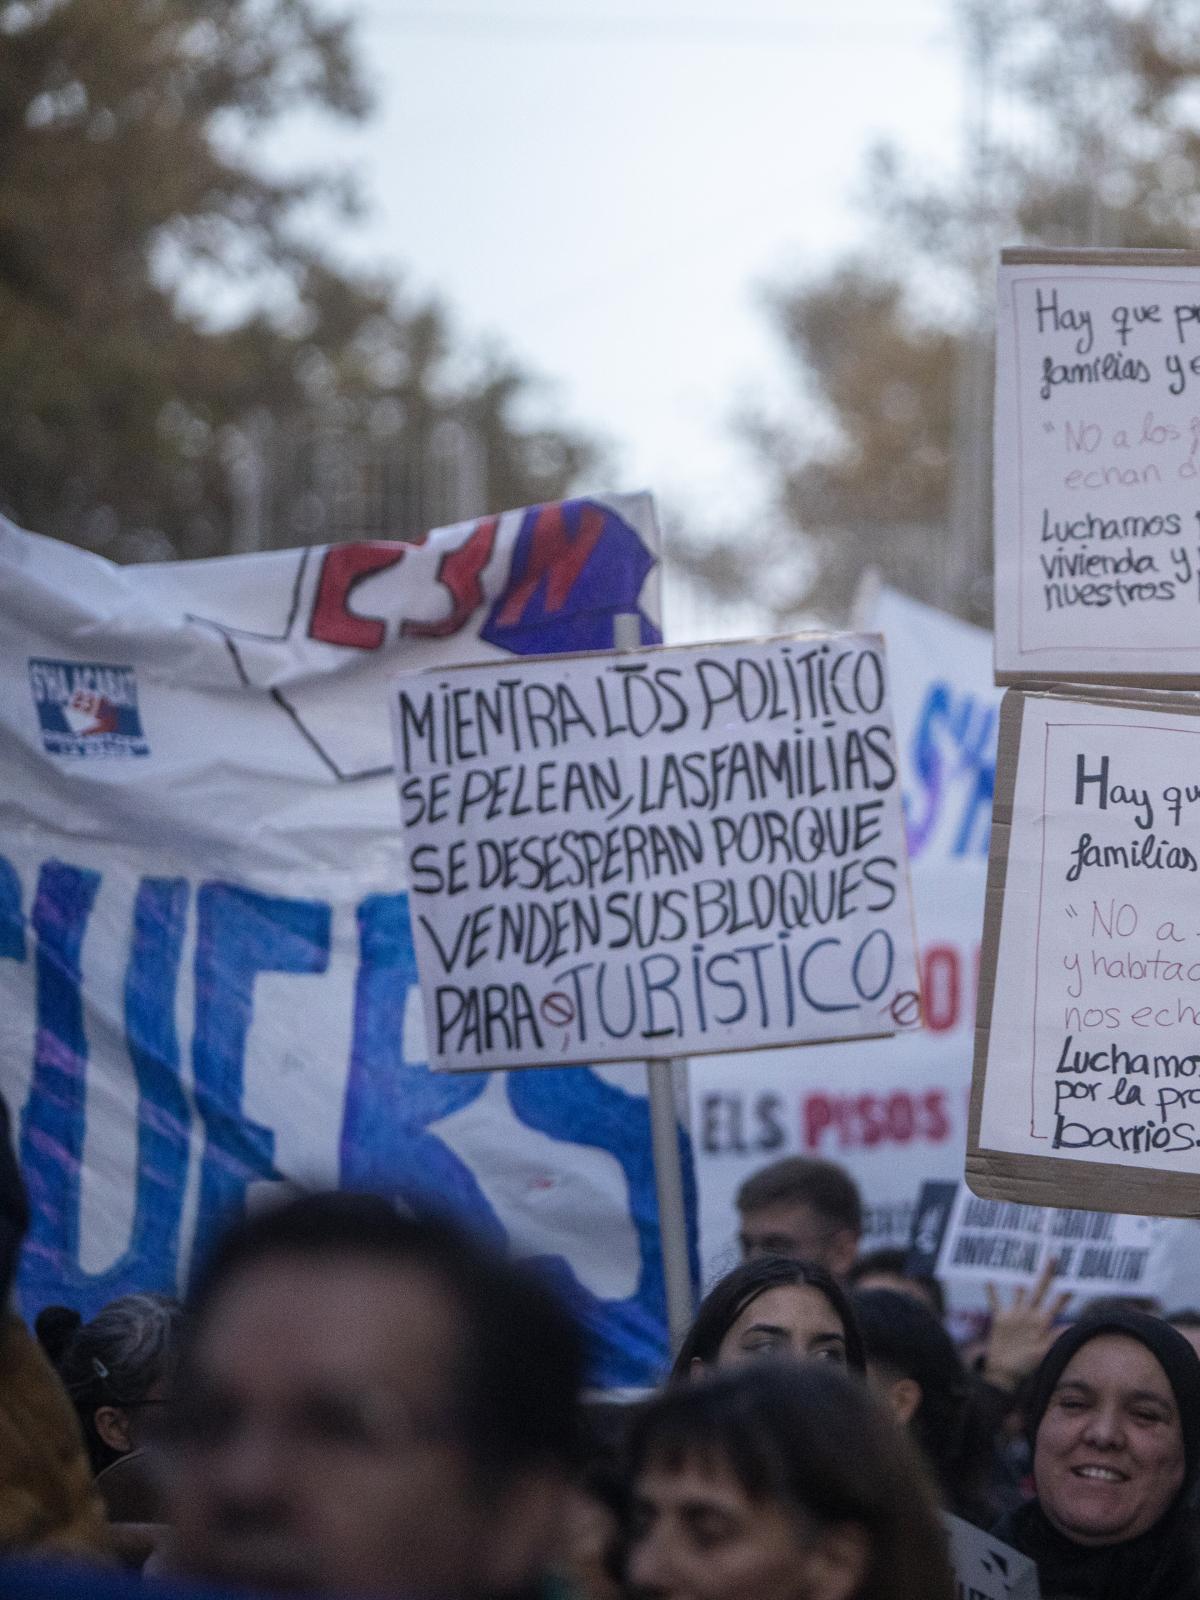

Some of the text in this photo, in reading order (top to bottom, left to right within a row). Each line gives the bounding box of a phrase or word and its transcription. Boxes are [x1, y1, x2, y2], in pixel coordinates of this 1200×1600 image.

[1035, 288, 1095, 354] Hay
[1112, 303, 1162, 345] que
[1041, 356, 1150, 399] familias
[1166, 355, 1187, 395] y
[1112, 430, 1129, 448] a
[1139, 412, 1181, 445] los
[1041, 508, 1181, 543] Luchamos
[1041, 545, 1157, 579] vivienda
[1173, 547, 1192, 583] y
[1043, 578, 1176, 611] nuestros
[399, 678, 595, 773] MIENTRA
[600, 664, 689, 738] LOS
[402, 722, 897, 827] SE PELEAN, LAS FAMILIAS
[1075, 753, 1154, 829] Hay
[411, 800, 884, 895] SE DESESPERAN PORQUE
[1066, 833, 1199, 883] familias
[419, 856, 898, 975] VENDEN SUS BLOQUES
[1156, 919, 1185, 943] a
[1063, 957, 1085, 998] y
[437, 981, 544, 1055] PARA
[1063, 1003, 1122, 1031] nos
[1055, 1079, 1101, 1115] por
[1111, 1077, 1144, 1108] la
[703, 1090, 952, 1155] ELS PISOS
